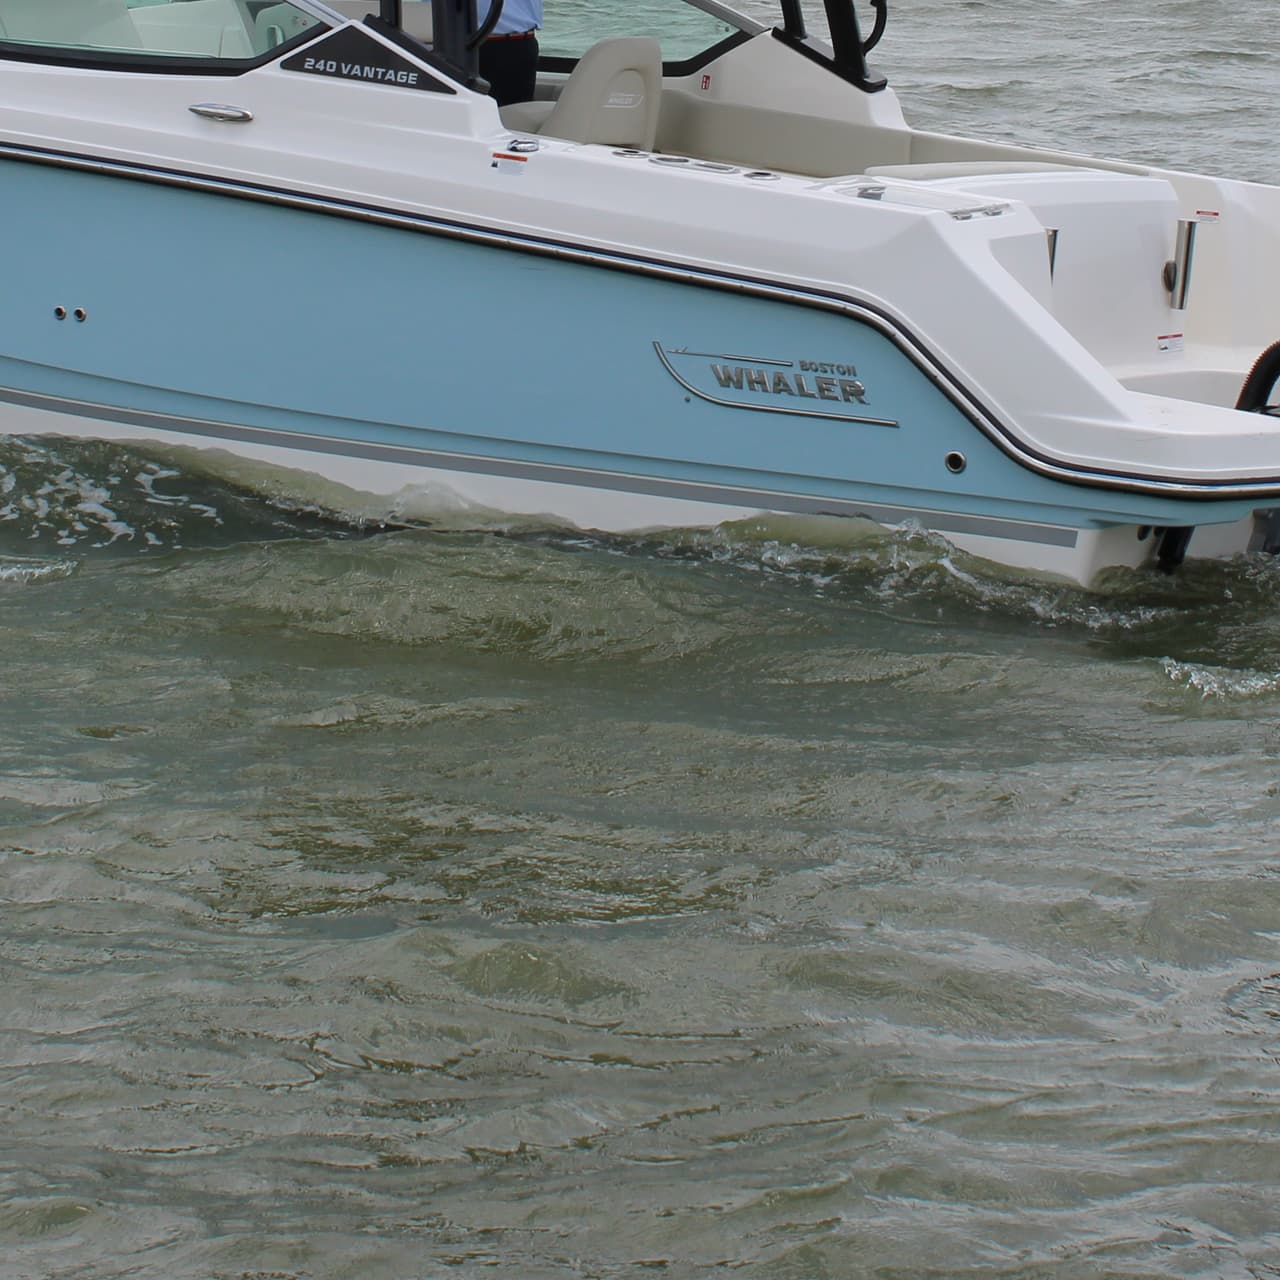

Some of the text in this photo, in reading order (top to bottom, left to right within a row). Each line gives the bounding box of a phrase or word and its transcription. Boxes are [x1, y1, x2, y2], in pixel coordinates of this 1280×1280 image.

[304, 58, 419, 85] 240 VANTAGE
[798, 359, 857, 377] BOSTON
[710, 363, 870, 405] WHALER
